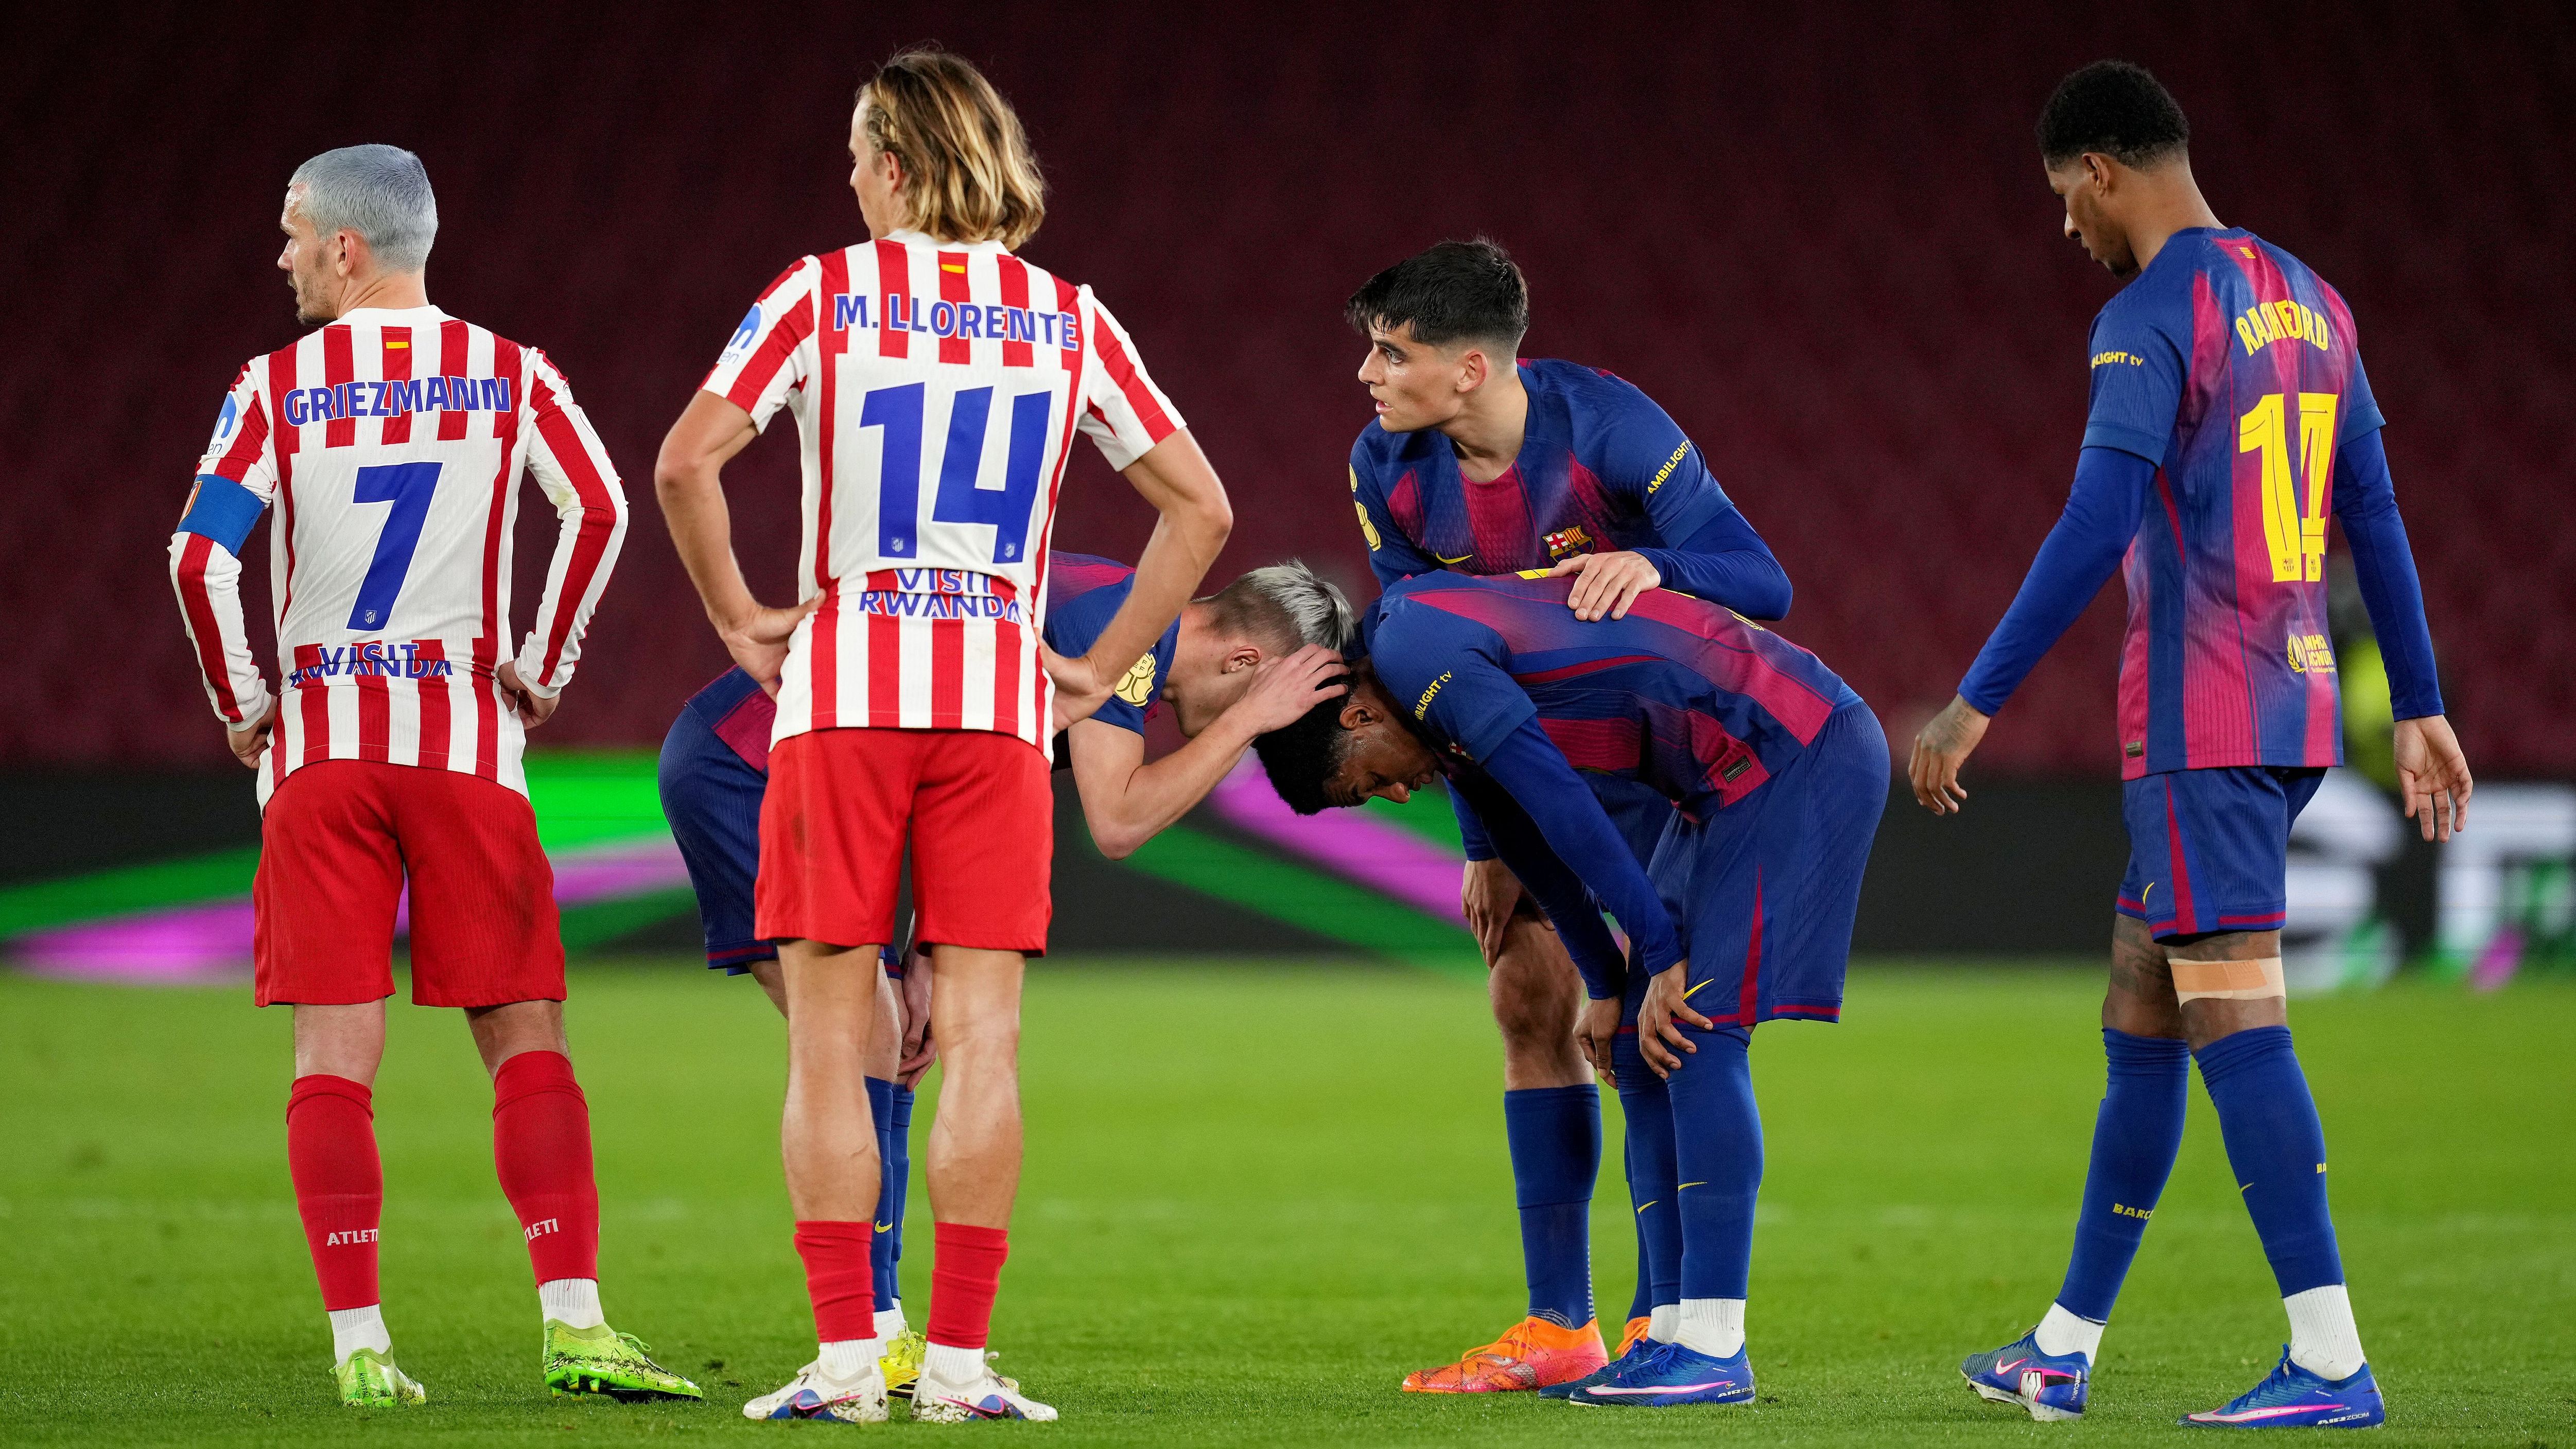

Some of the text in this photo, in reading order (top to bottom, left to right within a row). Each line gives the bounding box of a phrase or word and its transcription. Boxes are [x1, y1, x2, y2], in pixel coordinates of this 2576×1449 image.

[833, 293, 1077, 352] M. LLORENTE
[284, 377, 512, 427] GRIEZMANN
[859, 381, 1052, 564] 14
[1647, 441, 1689, 494] AMBILIGHT
[346, 461, 443, 632] 7
[318, 643, 419, 665] VISIT
[1439, 670, 1452, 683] tv
[1717, 1389, 1740, 1398] AIR
[2346, 1412, 2369, 1420] ZOOM
